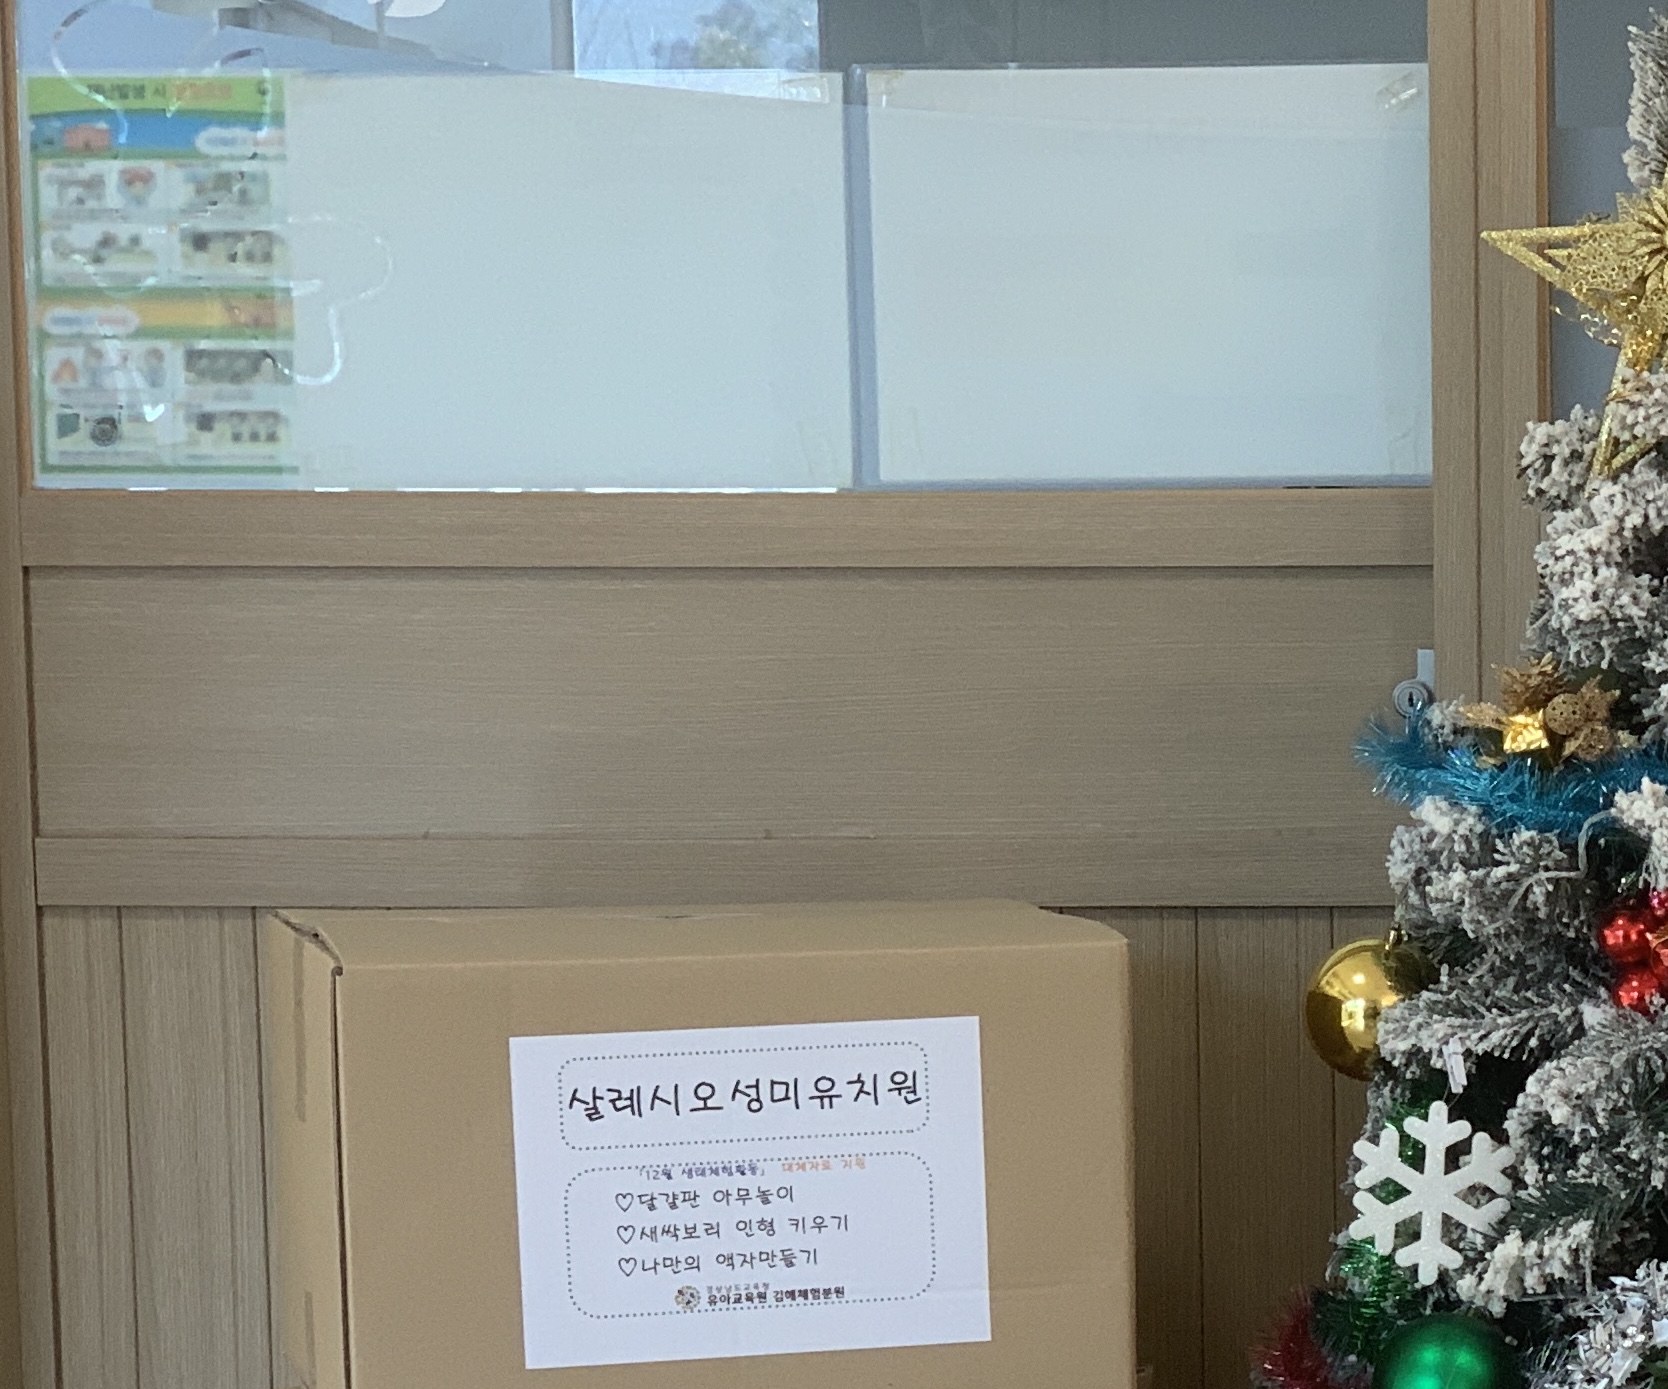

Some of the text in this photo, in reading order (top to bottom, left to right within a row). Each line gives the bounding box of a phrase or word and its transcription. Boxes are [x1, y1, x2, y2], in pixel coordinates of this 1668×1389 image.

[568, 1070, 923, 1122] 살레시오성미유치원
[781, 1160, 832, 1172] 대체자료
[842, 1158, 866, 1170] 지원
[638, 1186, 794, 1211] 달걀판 아무놀이
[639, 1215, 848, 1242] 새싹보리 인형 키우기
[641, 1249, 818, 1276] 나만의 액자만들기
[707, 1285, 845, 1306] 유아교육원 김해체험분원
